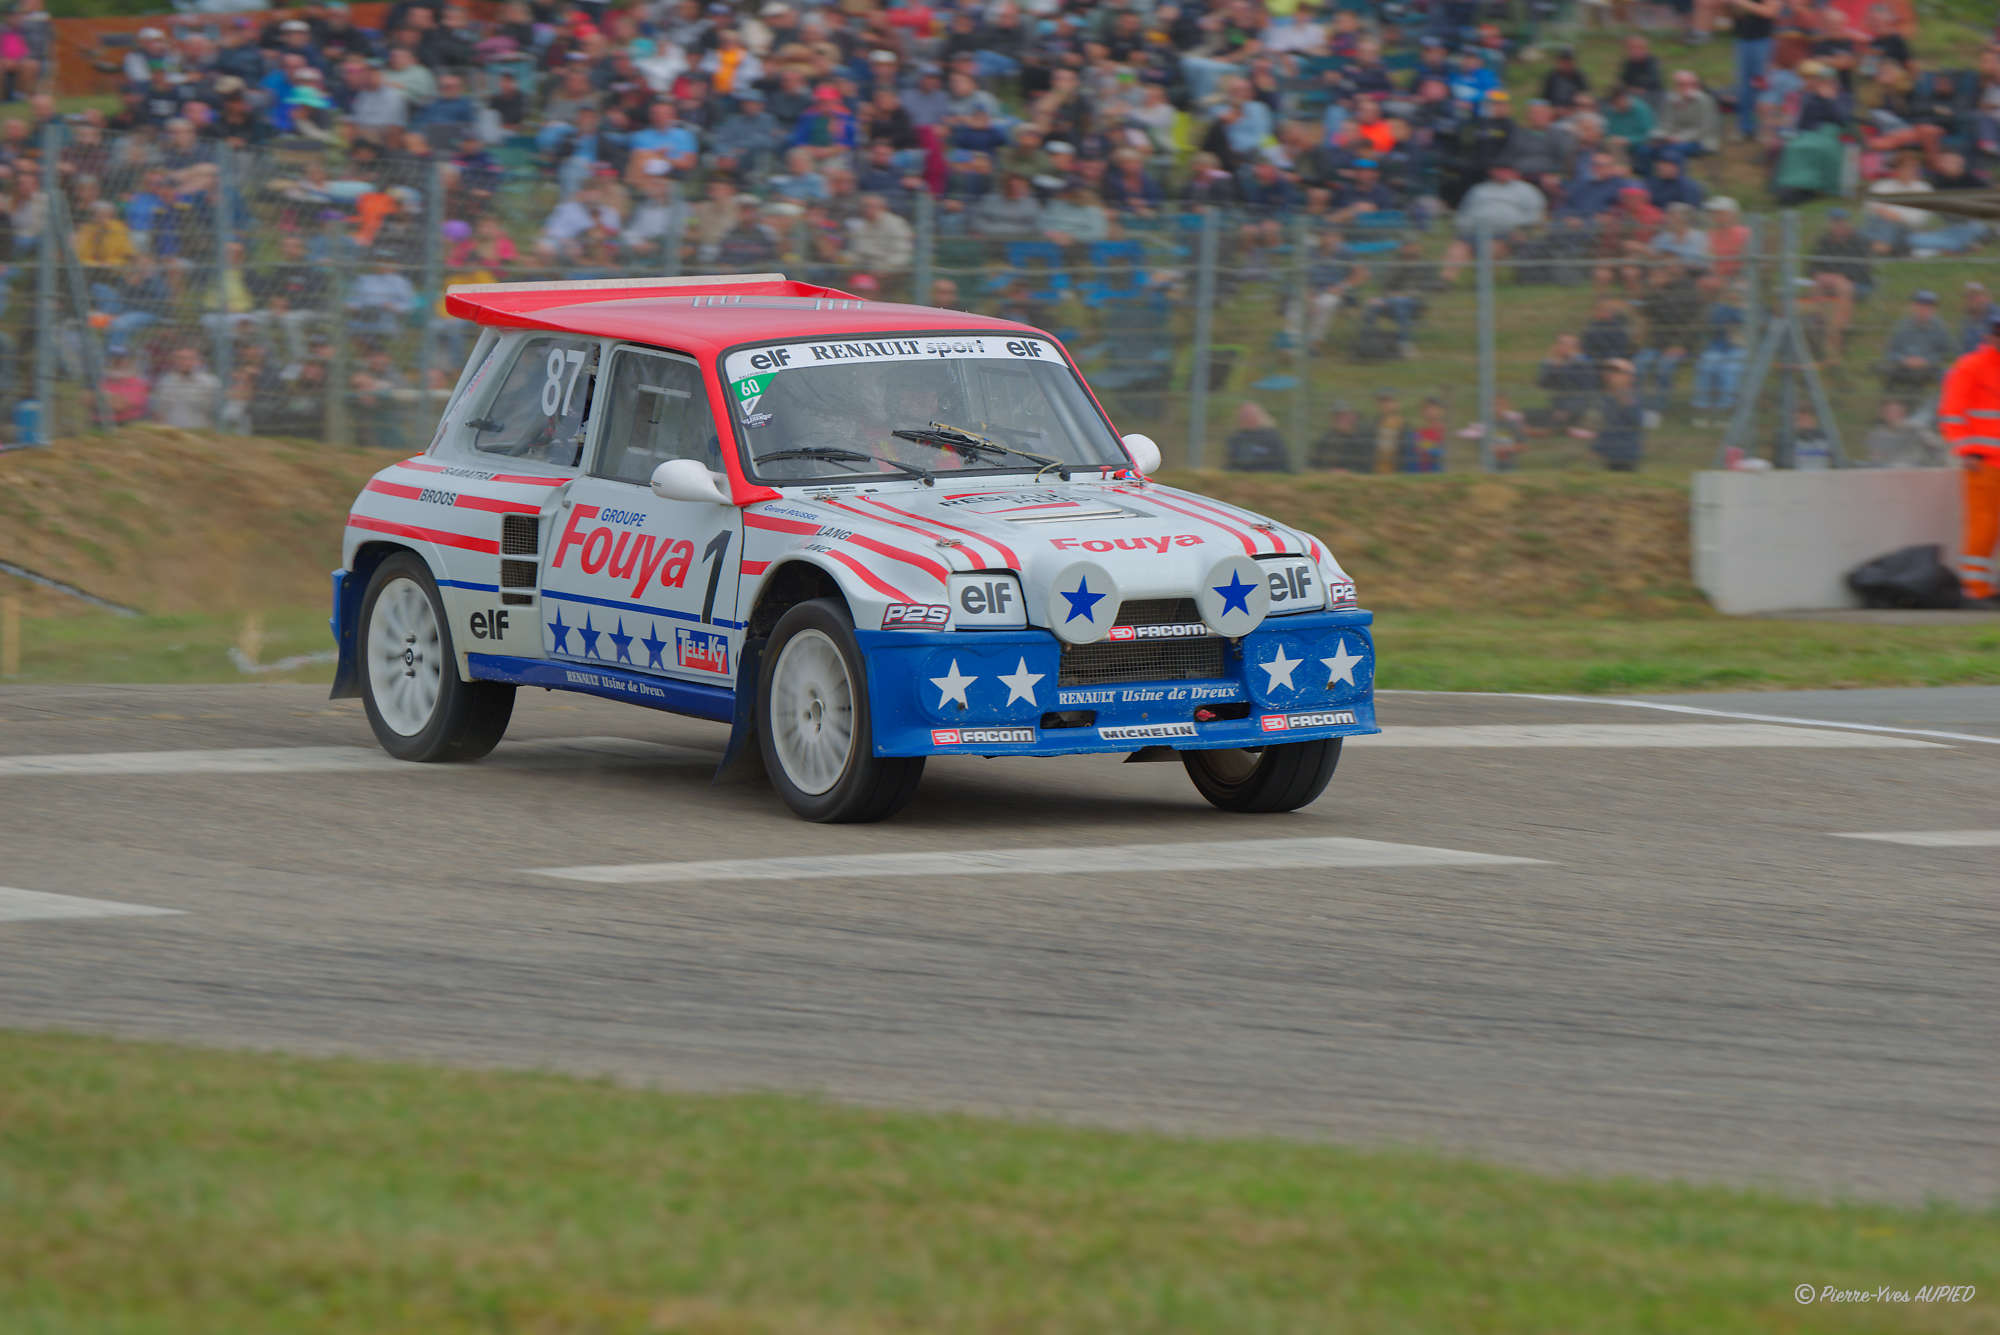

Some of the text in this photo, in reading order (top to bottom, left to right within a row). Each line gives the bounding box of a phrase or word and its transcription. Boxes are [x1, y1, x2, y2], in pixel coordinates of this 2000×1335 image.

[750, 339, 1041, 370] elf RENAULT sport elf
[542, 348, 585, 416] 87
[741, 379, 761, 396] 60
[420, 488, 456, 506] BROOS
[601, 508, 647, 527] GROUPE
[816, 526, 852, 540] LANG
[552, 503, 694, 599] Fouya
[1049, 534, 1205, 554] Fouya
[702, 530, 732, 624] 1
[1267, 566, 1312, 601] elf
[961, 582, 1012, 614] elf
[885, 604, 950, 624] P2S
[470, 609, 509, 640] elf
[1136, 624, 1206, 637] FACOM
[566, 671, 665, 697] RENAULT Usine de Dreux
[1059, 686, 1235, 705] RENAULT Usine de Dreux
[1289, 711, 1356, 728] FACOM
[962, 730, 1033, 742] FACOM
[1102, 726, 1194, 739] MICHELIN
